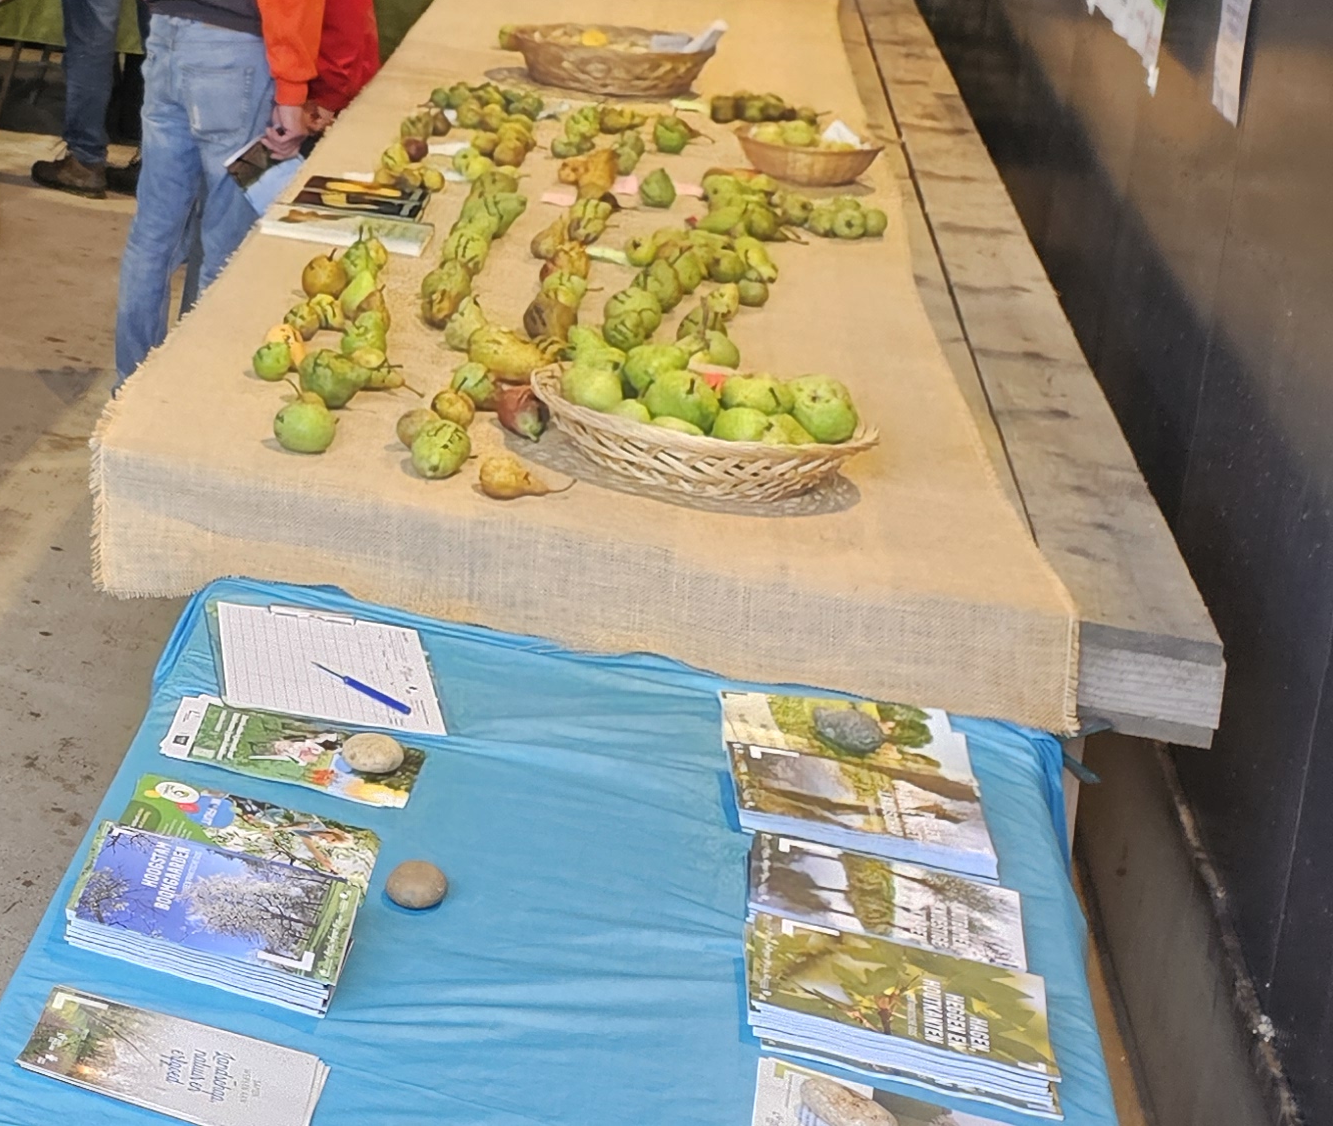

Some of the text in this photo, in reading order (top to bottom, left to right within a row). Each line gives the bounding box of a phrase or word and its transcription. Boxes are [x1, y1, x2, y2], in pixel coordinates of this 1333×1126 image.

[142, 841, 171, 889] HOOGSTAM
[153, 846, 190, 911] BOOMGAARDEN
[922, 979, 943, 1045] HOUTKANTEN
[945, 993, 966, 1049] HEGGEN EN
[969, 1017, 990, 1053] HAGEN,
